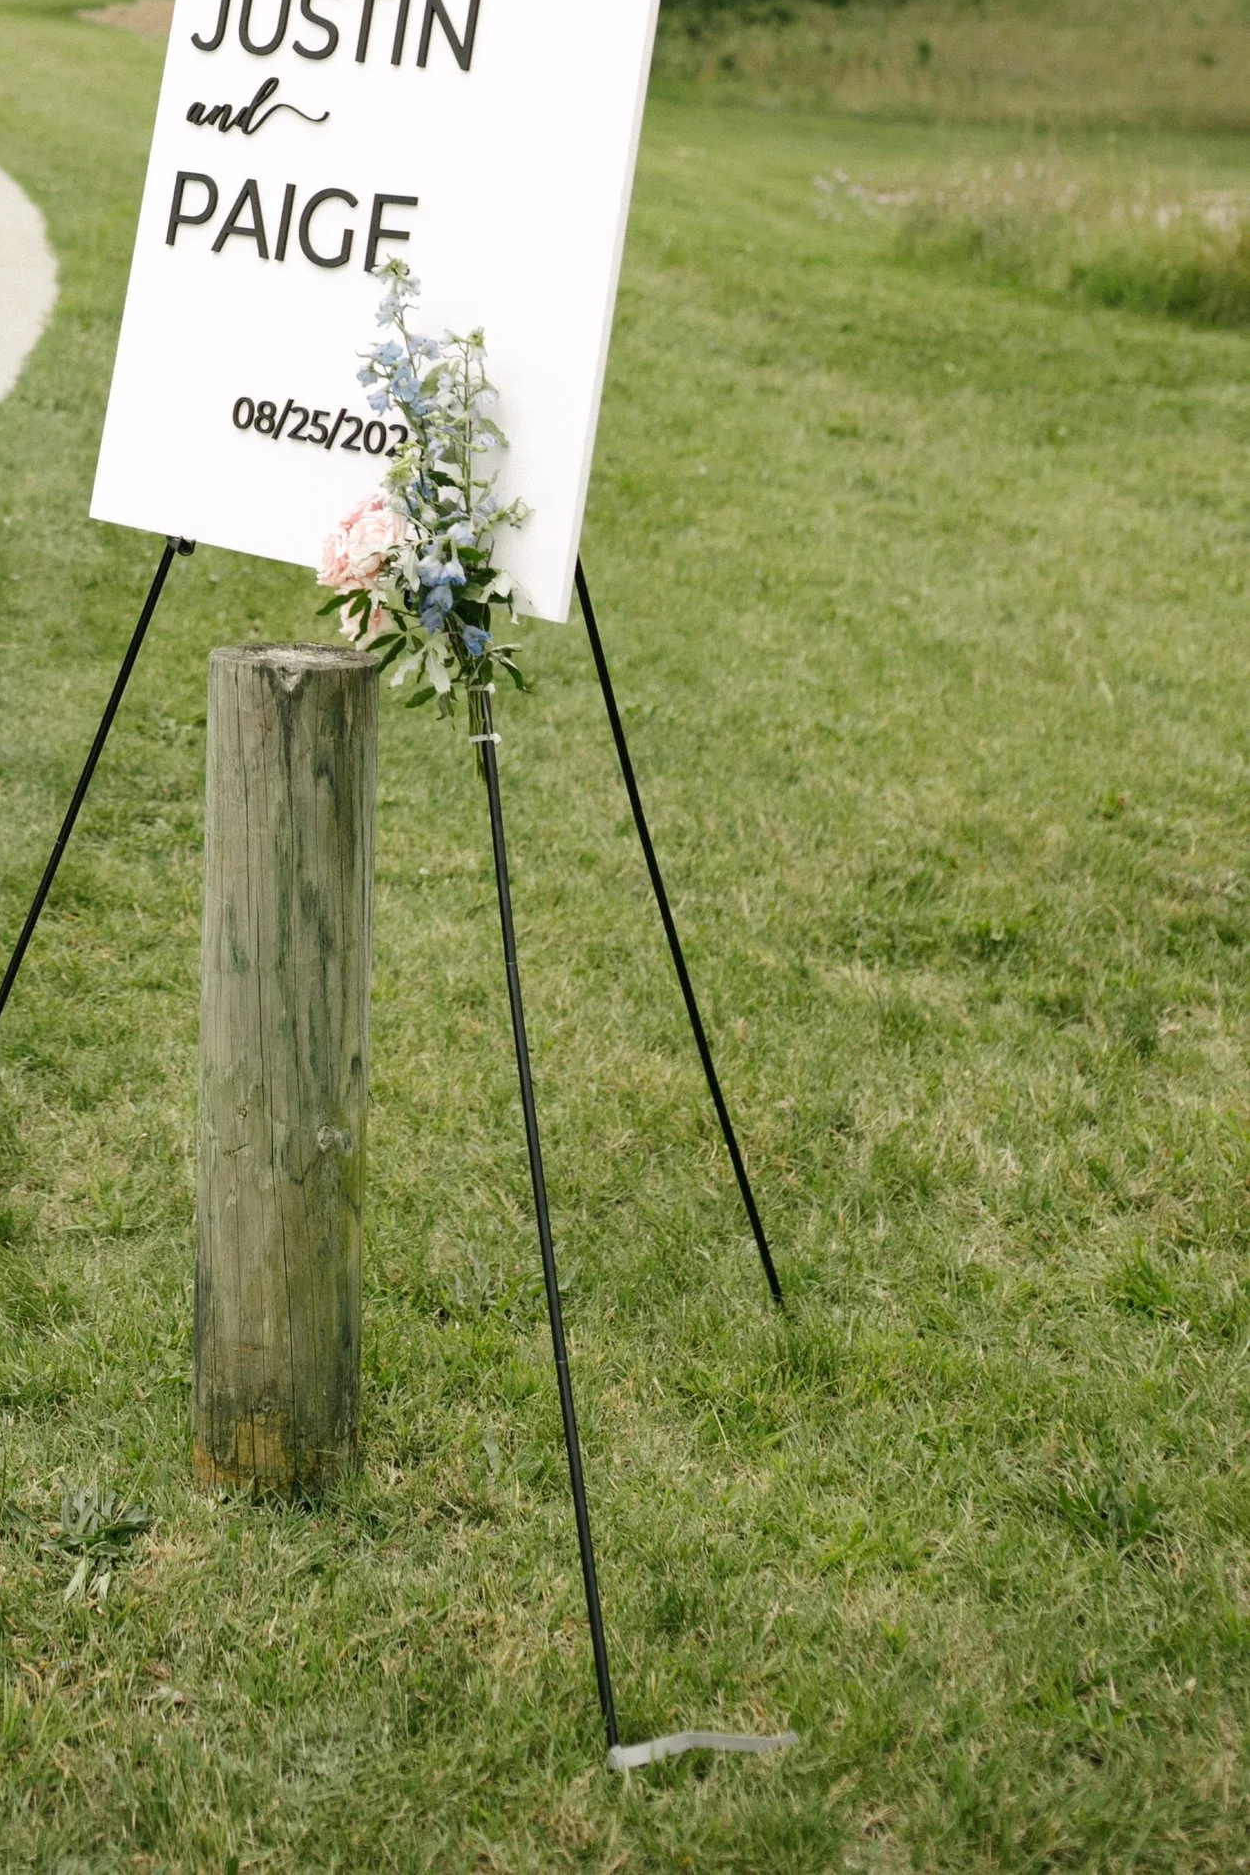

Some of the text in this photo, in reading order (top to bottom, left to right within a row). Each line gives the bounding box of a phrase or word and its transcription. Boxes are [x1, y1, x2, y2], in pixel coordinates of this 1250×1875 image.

[185, 76, 331, 136] and
[165, 170, 419, 275] PAIGE
[232, 396, 424, 460] 08/25/202
